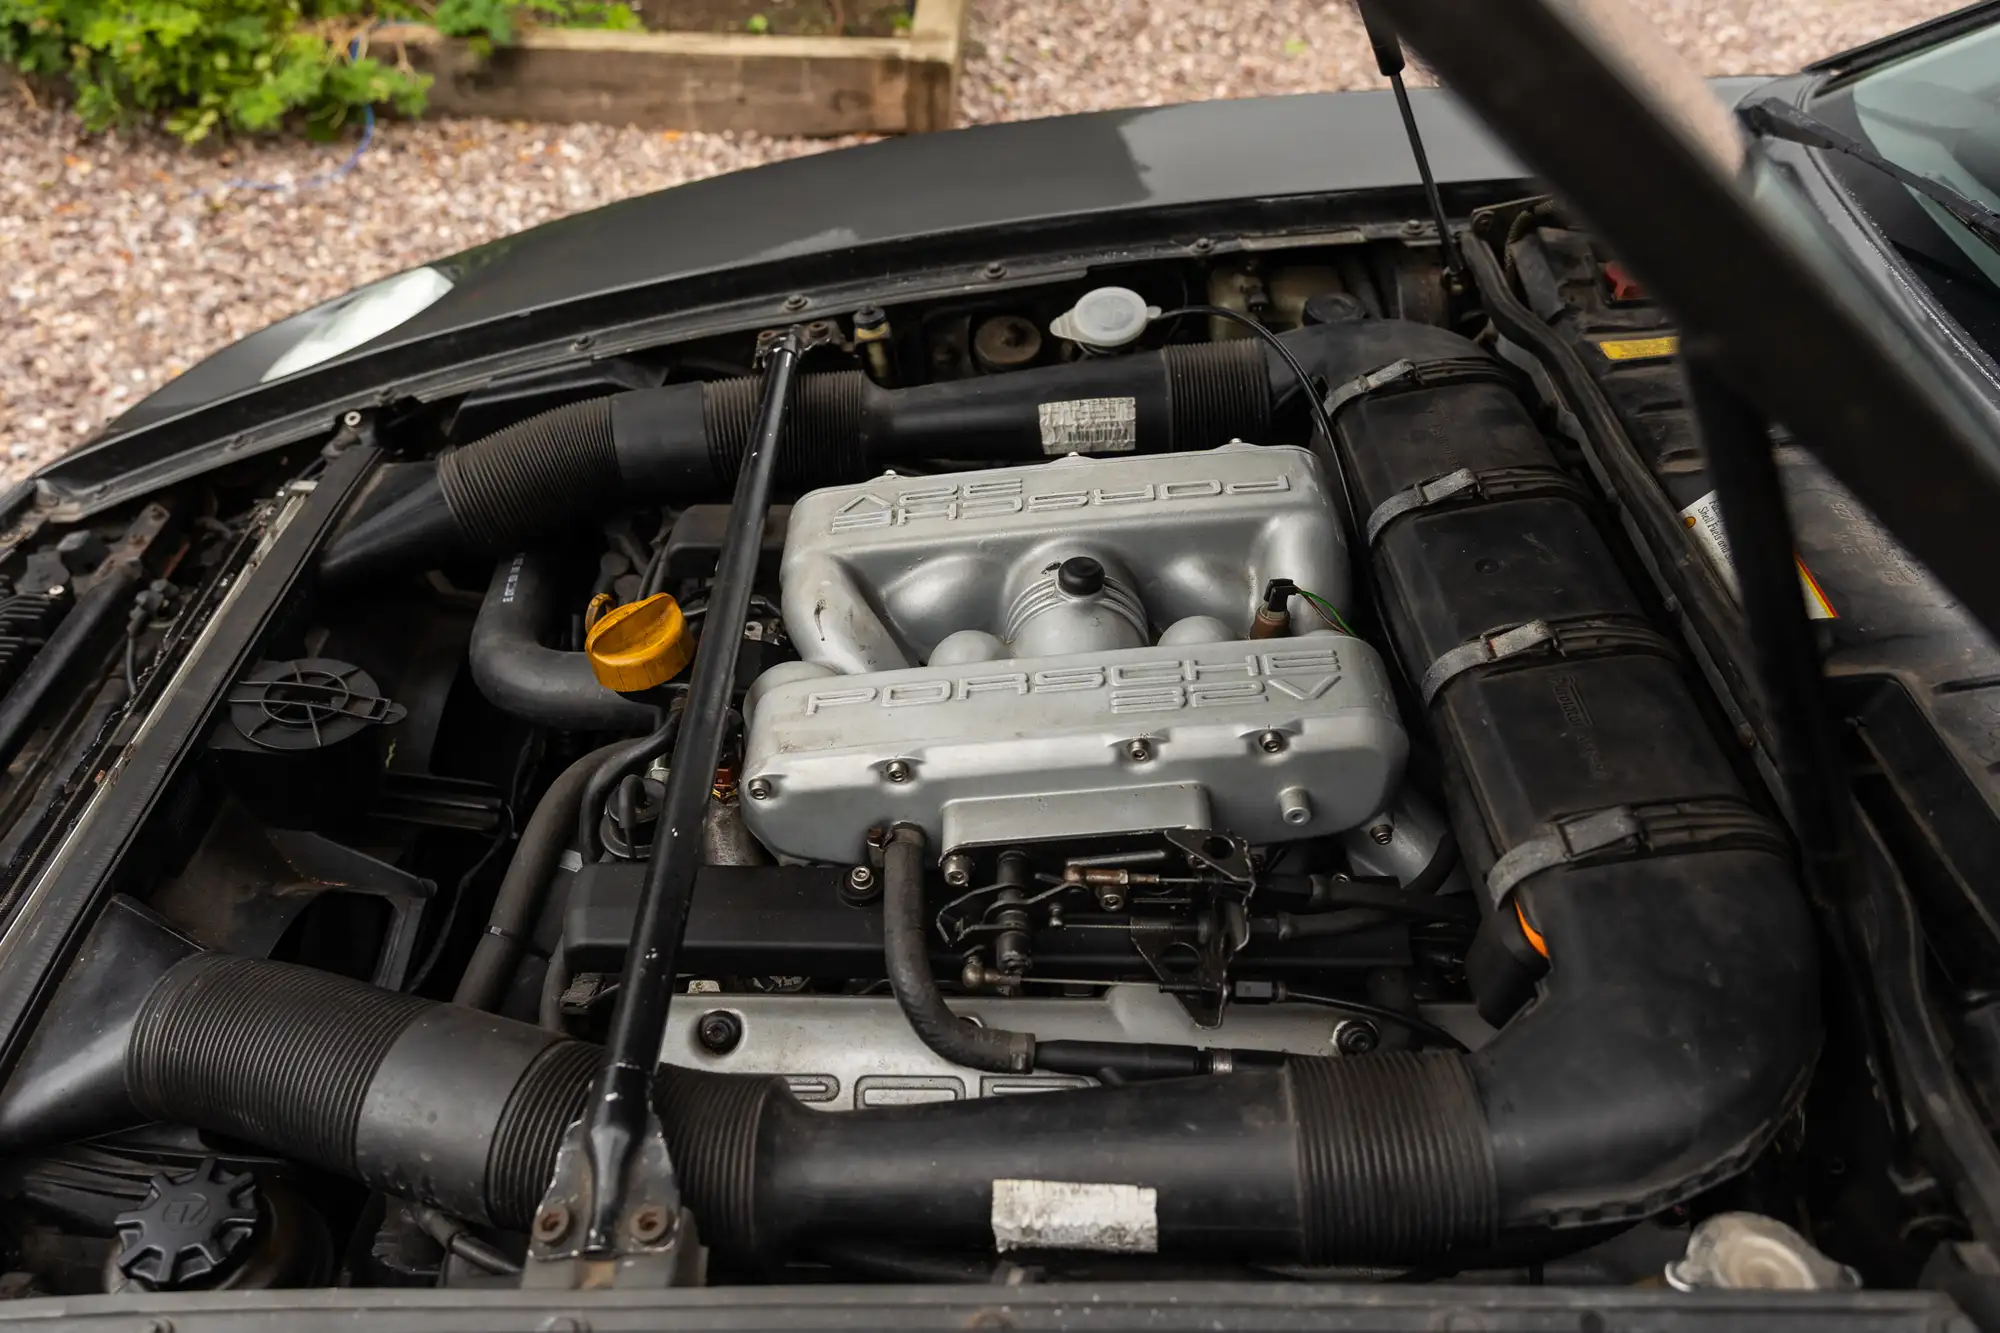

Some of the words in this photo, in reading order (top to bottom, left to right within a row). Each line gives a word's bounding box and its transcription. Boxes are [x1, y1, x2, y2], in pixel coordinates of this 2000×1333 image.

[831, 474, 1291, 533] PORSCHE
[836, 477, 1023, 513] 32V
[1698, 506, 1714, 524] Shell
[1707, 521, 1724, 541] Fuels
[1717, 540, 1732, 554] and
[805, 649, 1341, 717] PORSCHE
[1110, 675, 1341, 715] 32V
